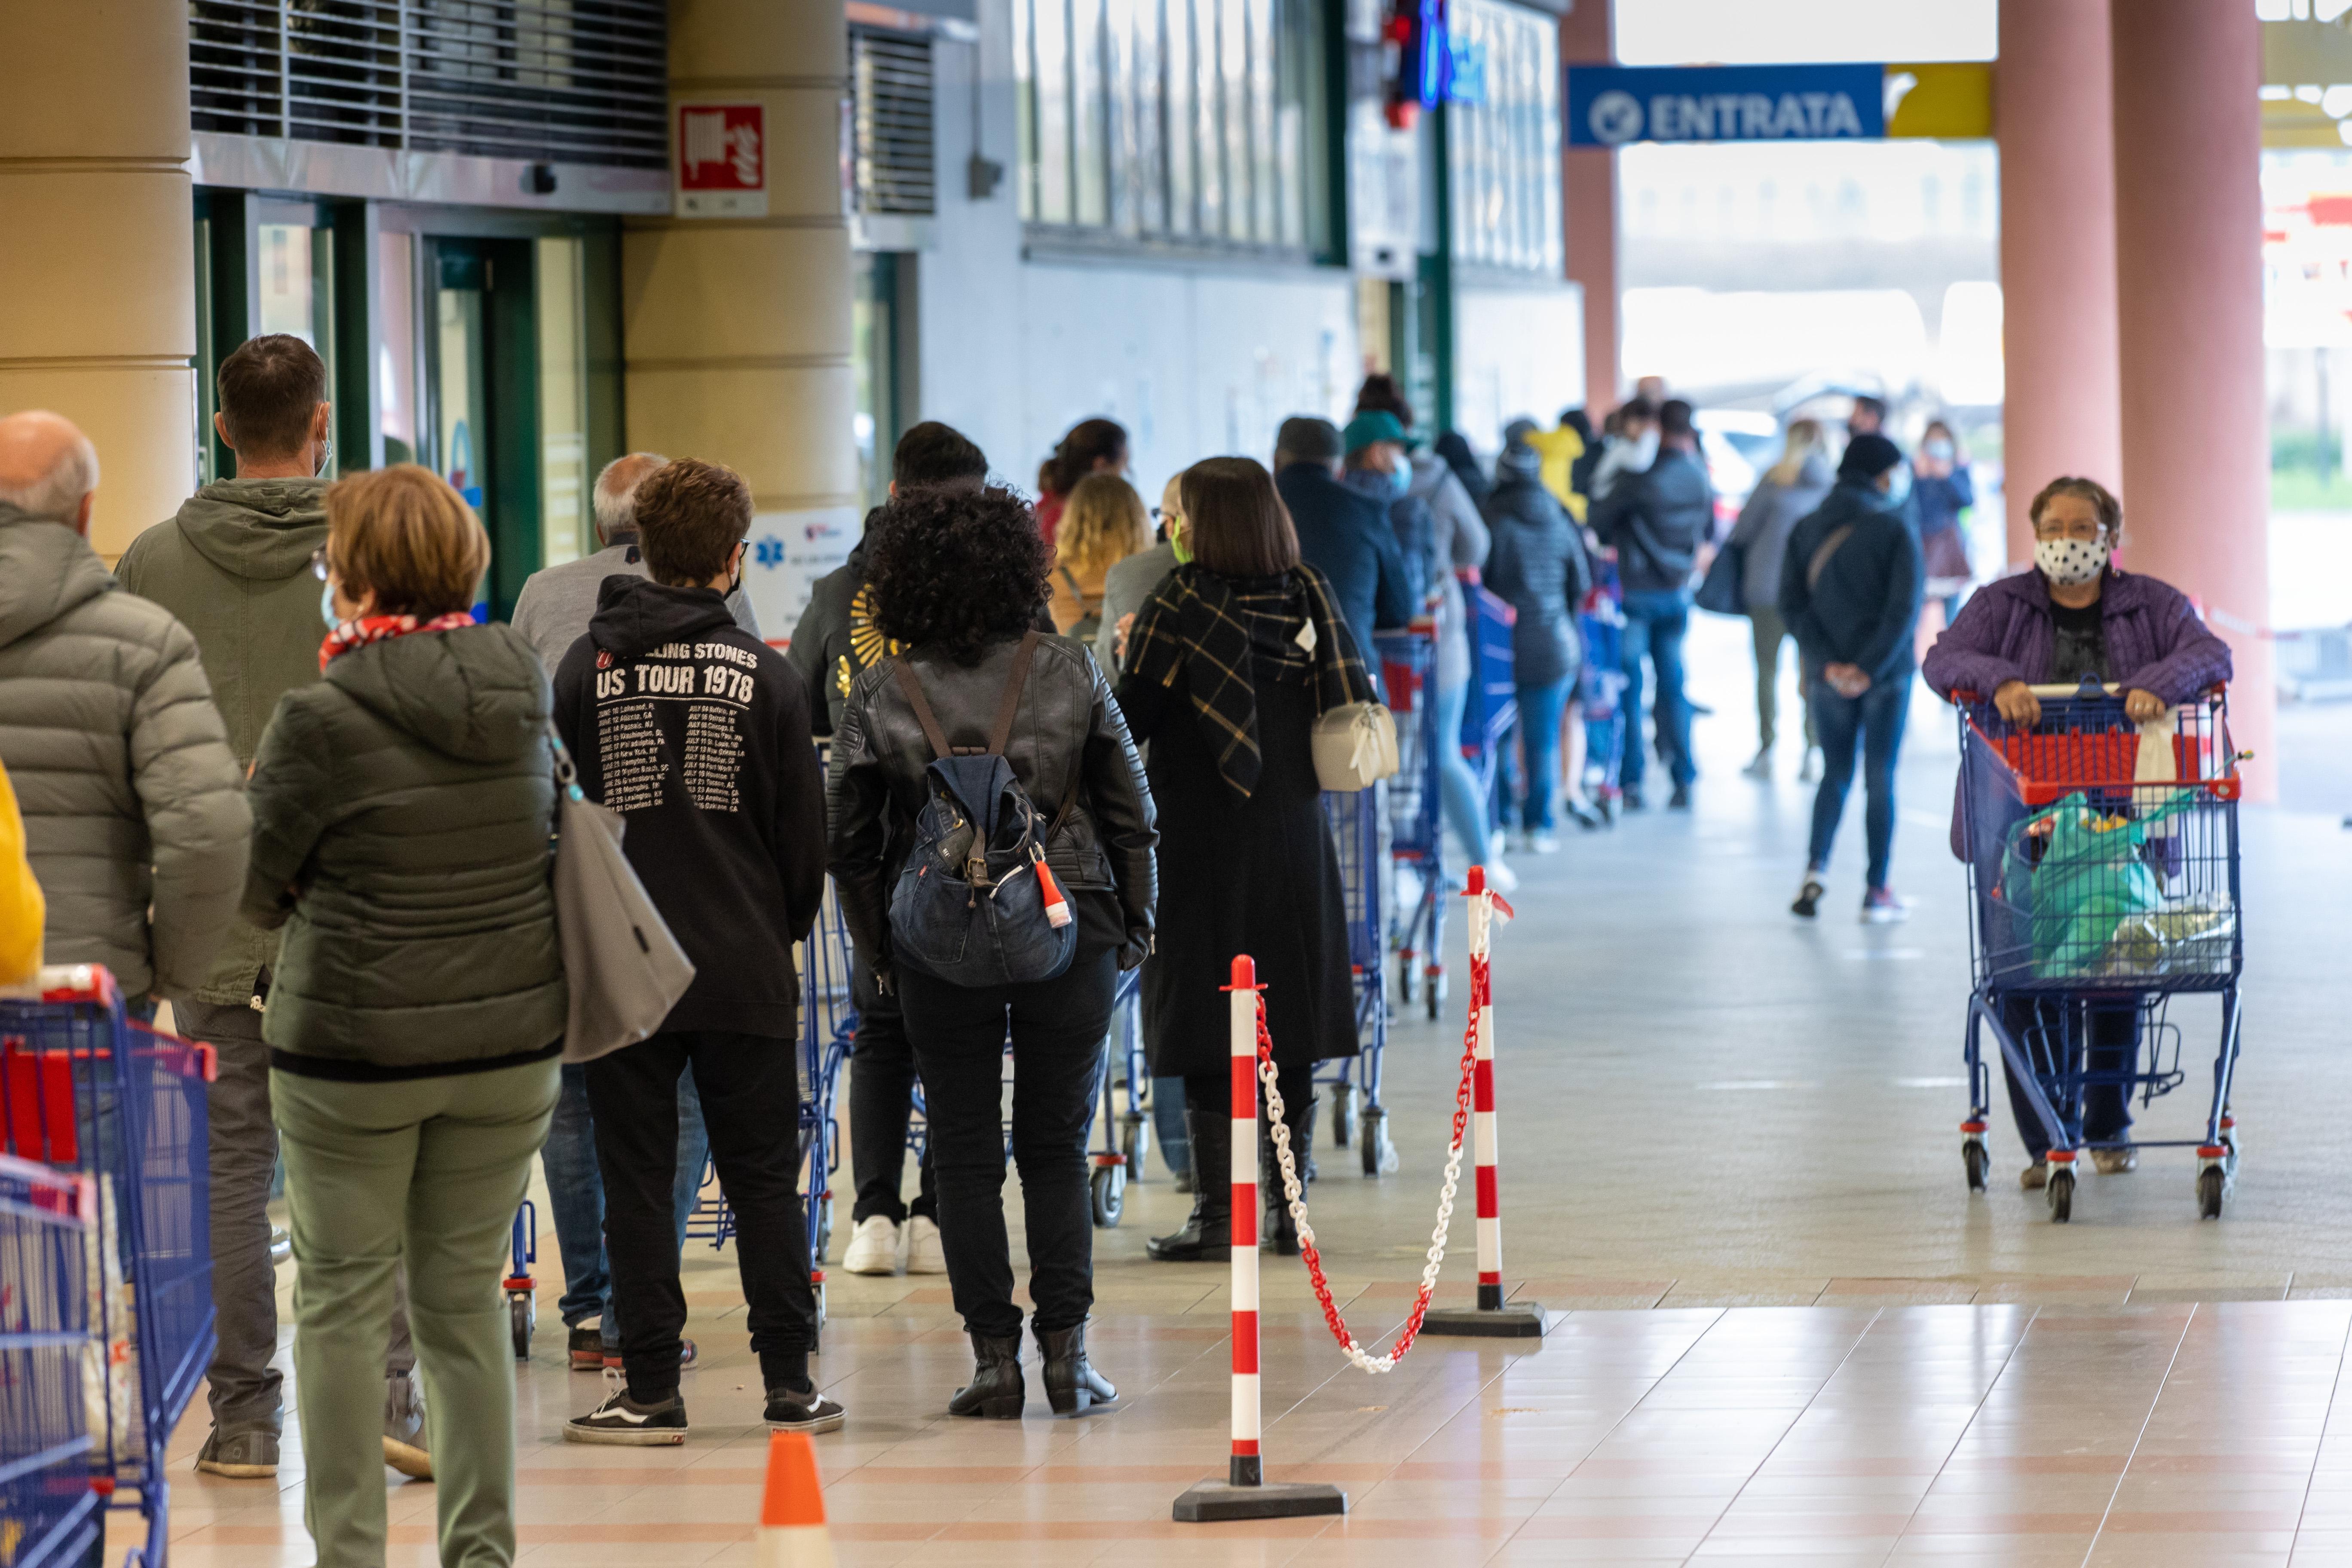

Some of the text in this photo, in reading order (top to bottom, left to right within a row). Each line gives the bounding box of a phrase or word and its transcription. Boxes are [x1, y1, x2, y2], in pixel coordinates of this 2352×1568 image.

[1649, 91, 1862, 138] ENTRATA
[694, 643, 757, 670] STONES
[596, 665, 755, 704] US TOUR 1978
